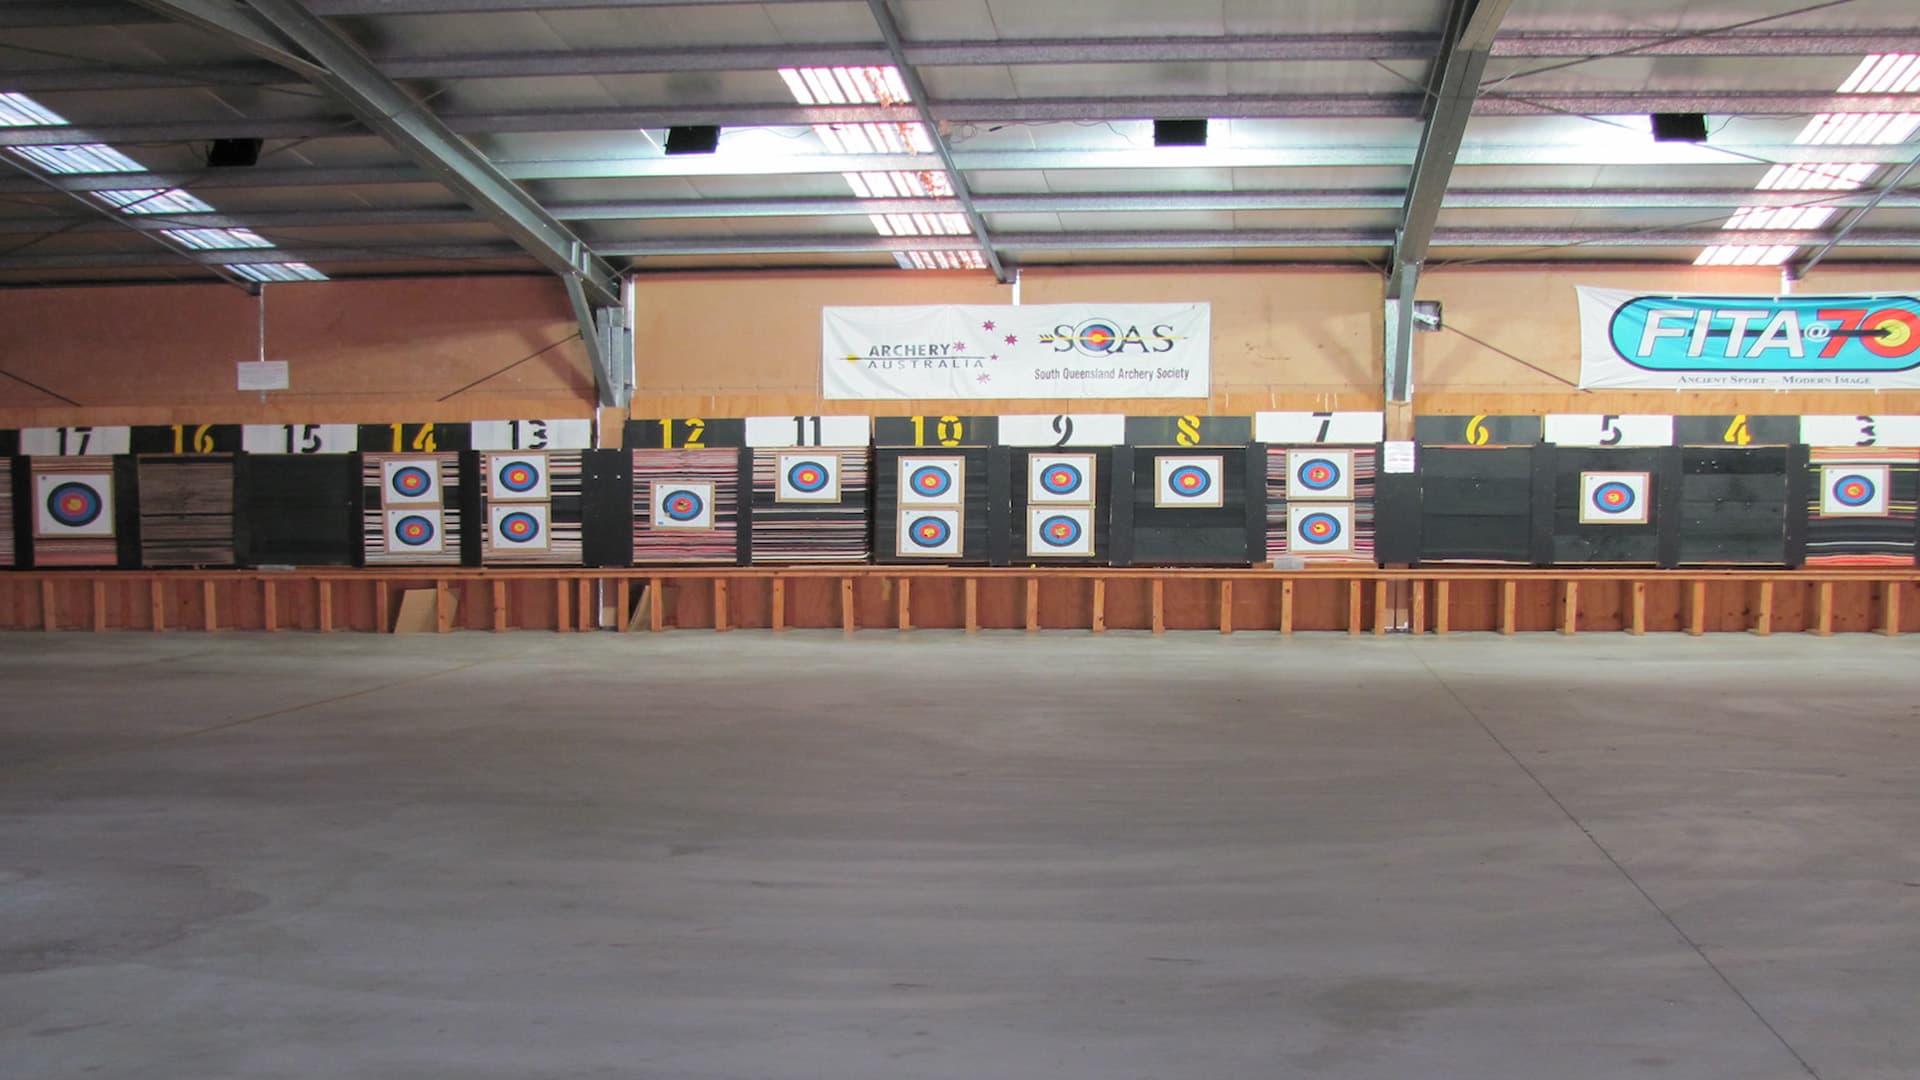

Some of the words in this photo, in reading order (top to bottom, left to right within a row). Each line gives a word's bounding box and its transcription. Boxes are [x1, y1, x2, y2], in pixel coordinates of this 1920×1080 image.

[868, 344, 951, 357] ARCHERY
[1053, 318, 1174, 357] SQAS
[867, 359, 984, 370] AUSTRALIA
[1034, 368, 1061, 380] South
[1063, 367, 1116, 380] Queensland
[1118, 367, 1154, 382] Archery
[1156, 367, 1190, 381] Society
[56, 427, 93, 456] 17
[171, 424, 215, 455] 16
[283, 424, 322, 454] 15
[389, 422, 437, 452] 14
[508, 420, 548, 450] 13
[658, 418, 705, 448] 12
[793, 415, 822, 446] 11
[910, 415, 963, 446] 10
[1052, 414, 1074, 447] 9
[1176, 415, 1200, 447] 8
[1312, 412, 1333, 443] 7
[1465, 415, 1489, 445] 6
[1600, 415, 1622, 446] 5
[1724, 414, 1751, 446] 4
[1856, 415, 1876, 446] 3
